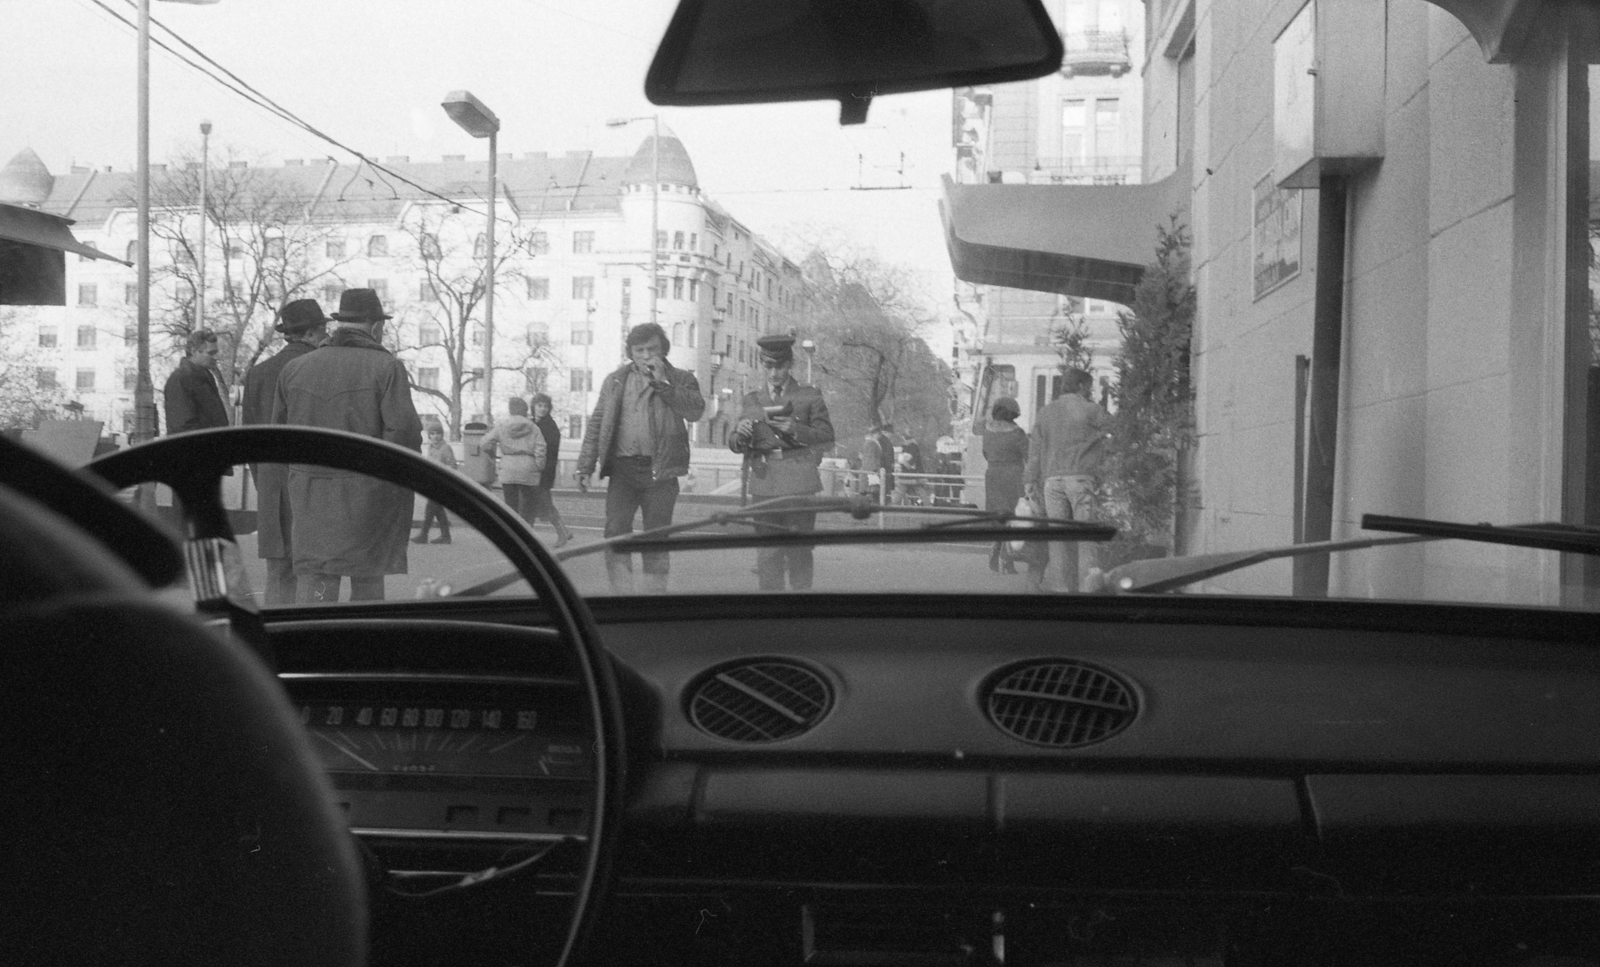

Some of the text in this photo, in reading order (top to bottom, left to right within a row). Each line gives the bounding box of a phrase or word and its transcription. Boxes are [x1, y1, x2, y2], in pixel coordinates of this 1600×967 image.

[326, 706, 343, 725] 20
[356, 707, 373, 726] 40
[380, 707, 398, 726] 60
[402, 708, 419, 727] 80
[424, 708, 444, 727] 100
[450, 708, 471, 728] 120
[481, 709, 502, 729] 140
[517, 710, 537, 730] 160
